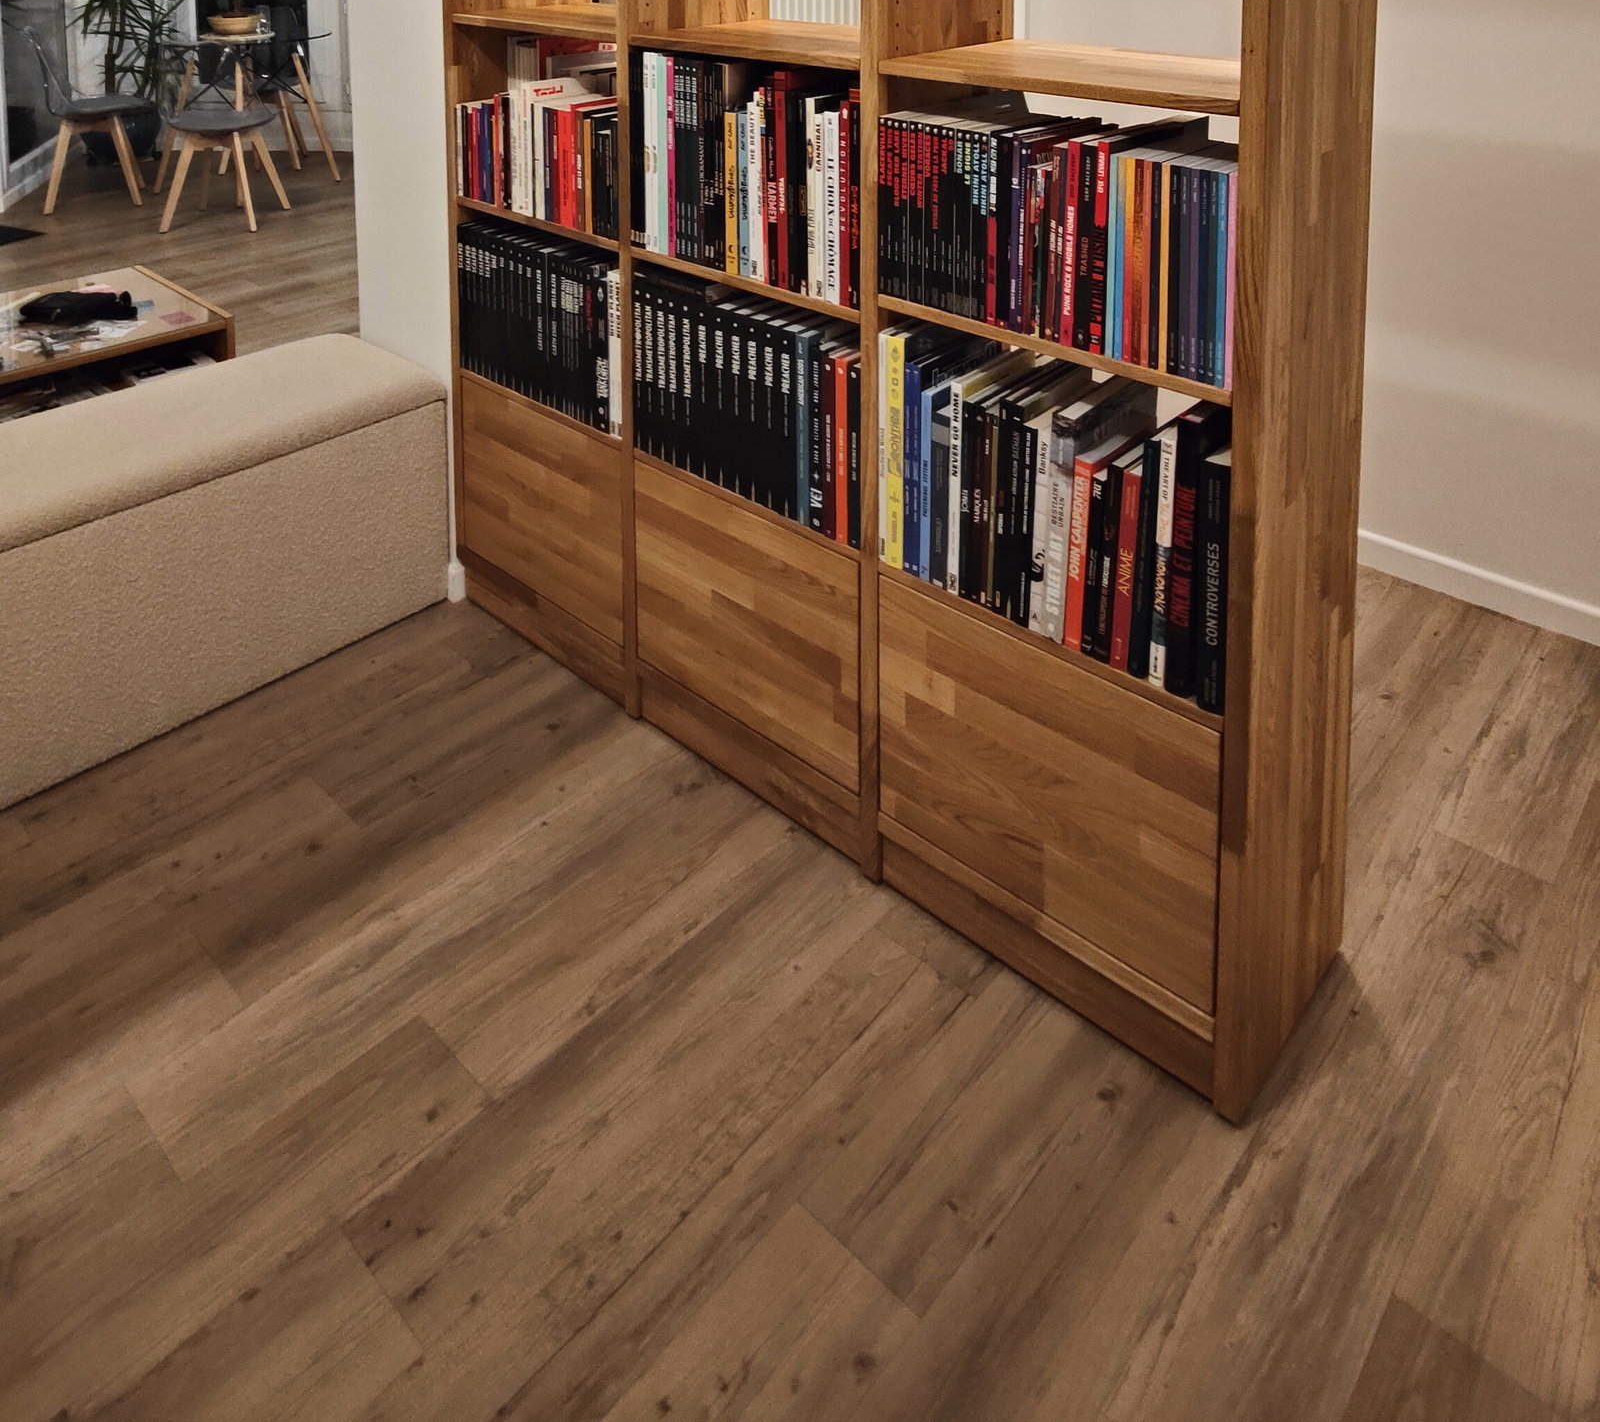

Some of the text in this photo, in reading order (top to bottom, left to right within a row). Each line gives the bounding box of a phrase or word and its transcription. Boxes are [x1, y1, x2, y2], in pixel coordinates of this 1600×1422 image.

[827, 157, 833, 172] LE
[933, 155, 939, 163] LA
[932, 193, 938, 202] AU
[965, 174, 970, 185] LE
[768, 182, 777, 223] KARMEN
[1066, 206, 1074, 233] HOMES
[827, 230, 837, 291] CHÔMAGE
[1065, 235, 1073, 264] MOBILE
[1080, 236, 1088, 276] TRASHED
[634, 301, 642, 381] TRANSMETROPOLITAN
[657, 311, 665, 389] TRANSMETROPOLITAN
[683, 318, 691, 398] TRANSMETROPOLITAN
[699, 324, 707, 363] PREACHER
[715, 330, 723, 369] PREACHER
[732, 335, 740, 375] PREACHER
[748, 341, 757, 380] PREACHER
[765, 347, 773, 387] PREACHER
[781, 353, 790, 394] PREACHER
[797, 376, 805, 406] AMERICAN
[951, 392, 959, 422] HOME
[951, 426, 959, 441] GO
[1038, 441, 1048, 475] Banksy
[810, 487, 822, 508] VEI
[1161, 490, 1168, 501] OF
[1069, 476, 1085, 580] JOHN CARPENTER
[1175, 483, 1195, 548] PEINTURE
[1046, 530, 1062, 615] STREET ART
[1118, 548, 1133, 597] ANIME
[1174, 554, 1191, 571] ET
[1206, 542, 1219, 646] CONTROVERSES
